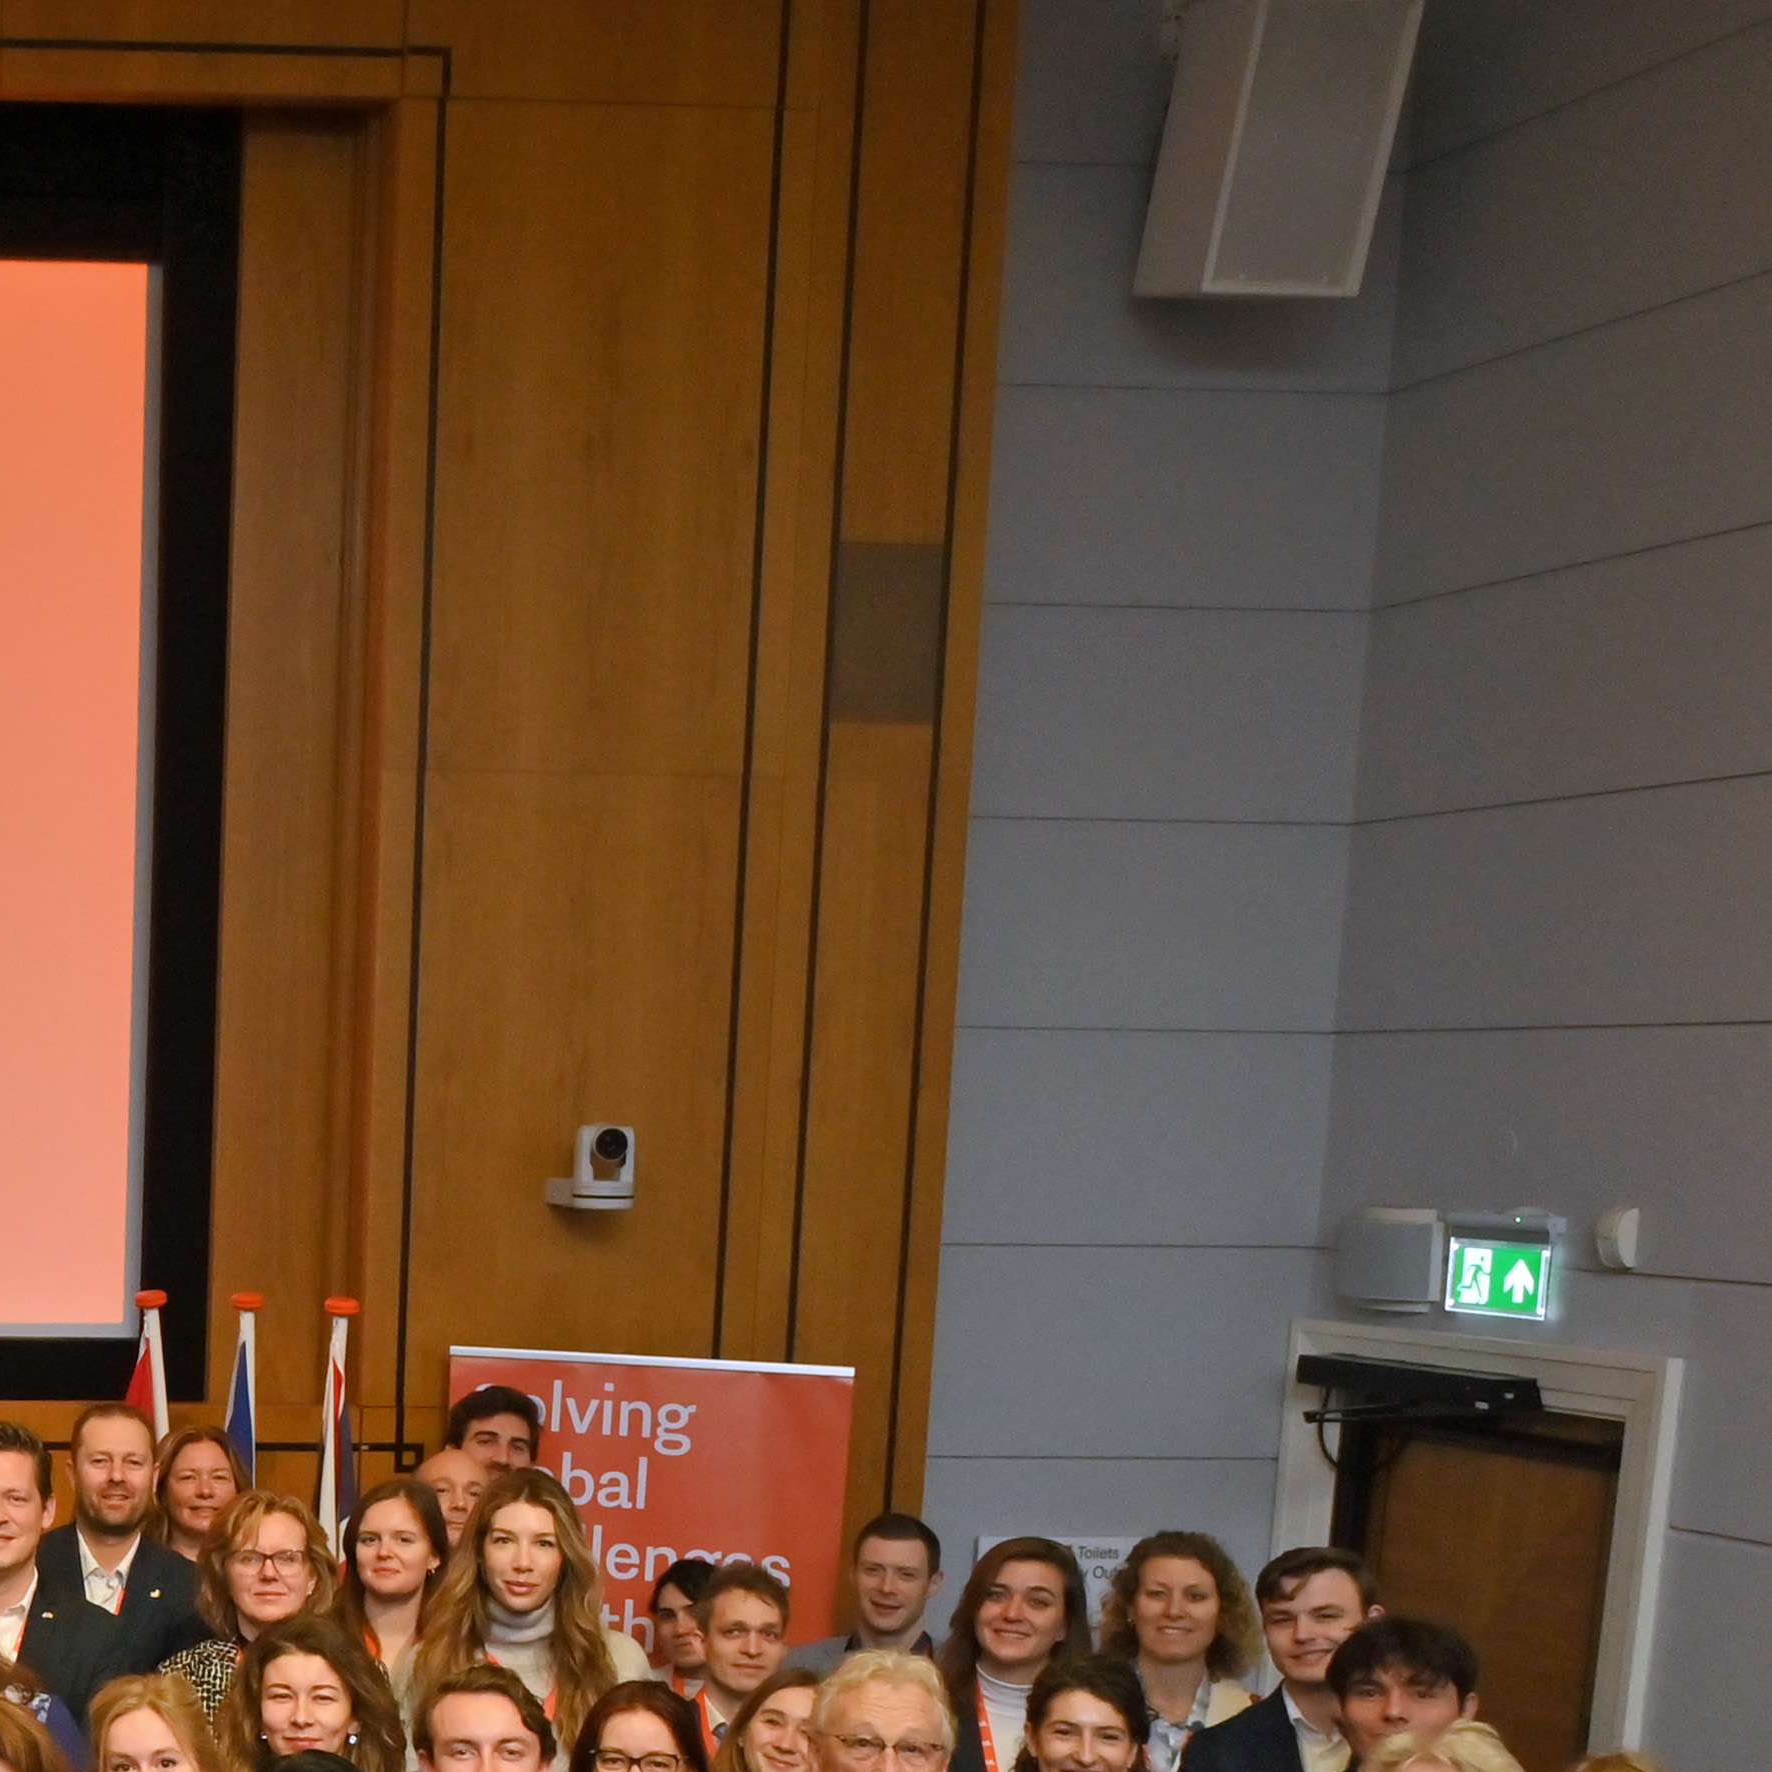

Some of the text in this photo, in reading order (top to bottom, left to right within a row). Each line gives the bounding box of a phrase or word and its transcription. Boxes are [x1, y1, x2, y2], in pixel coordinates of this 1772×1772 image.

[475, 1379, 697, 1457] lving
[534, 1451, 649, 1510] bal
[1078, 1546, 1120, 1560] Toilets
